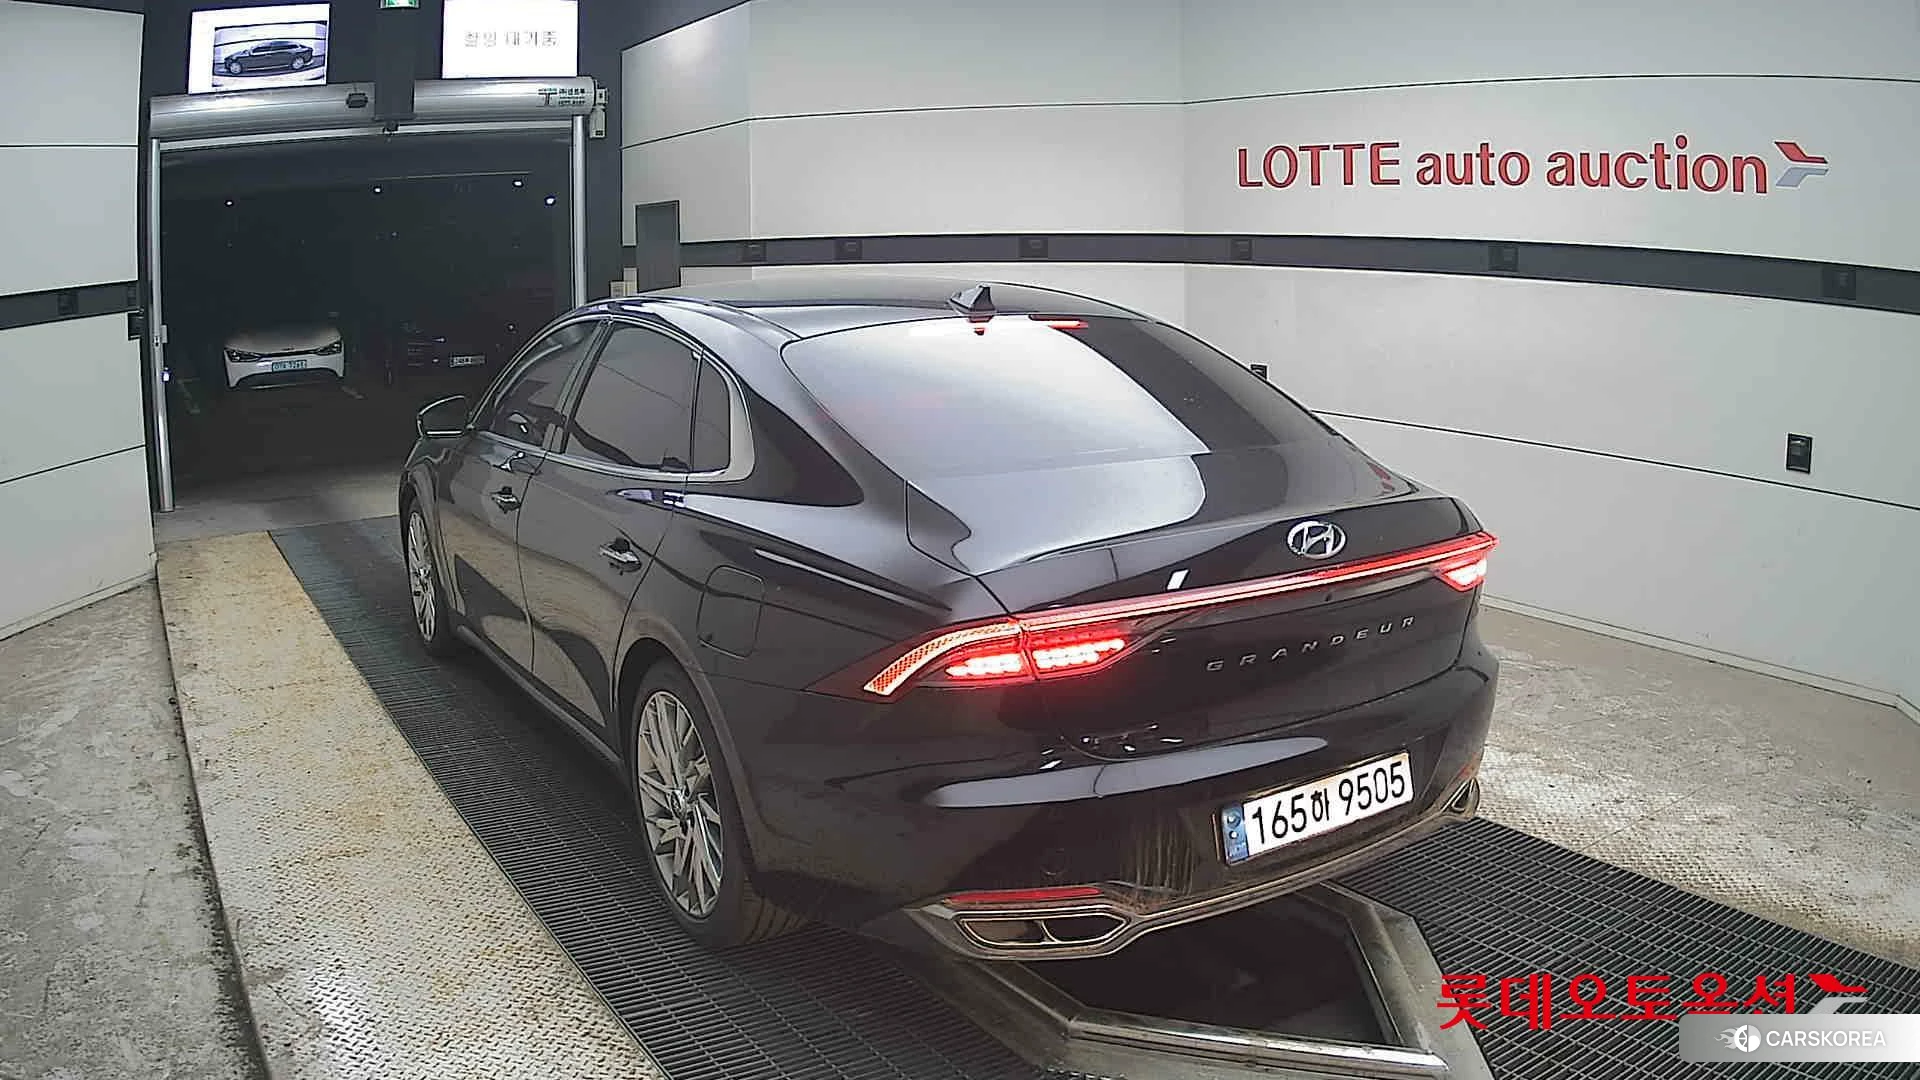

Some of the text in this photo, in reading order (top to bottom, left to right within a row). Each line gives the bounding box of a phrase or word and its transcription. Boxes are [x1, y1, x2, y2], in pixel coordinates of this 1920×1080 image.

[1237, 134, 1768, 194] LOTTE auto auction
[1206, 616, 1414, 672] GRANDEUR
[1252, 761, 1406, 845] 165하 9505
